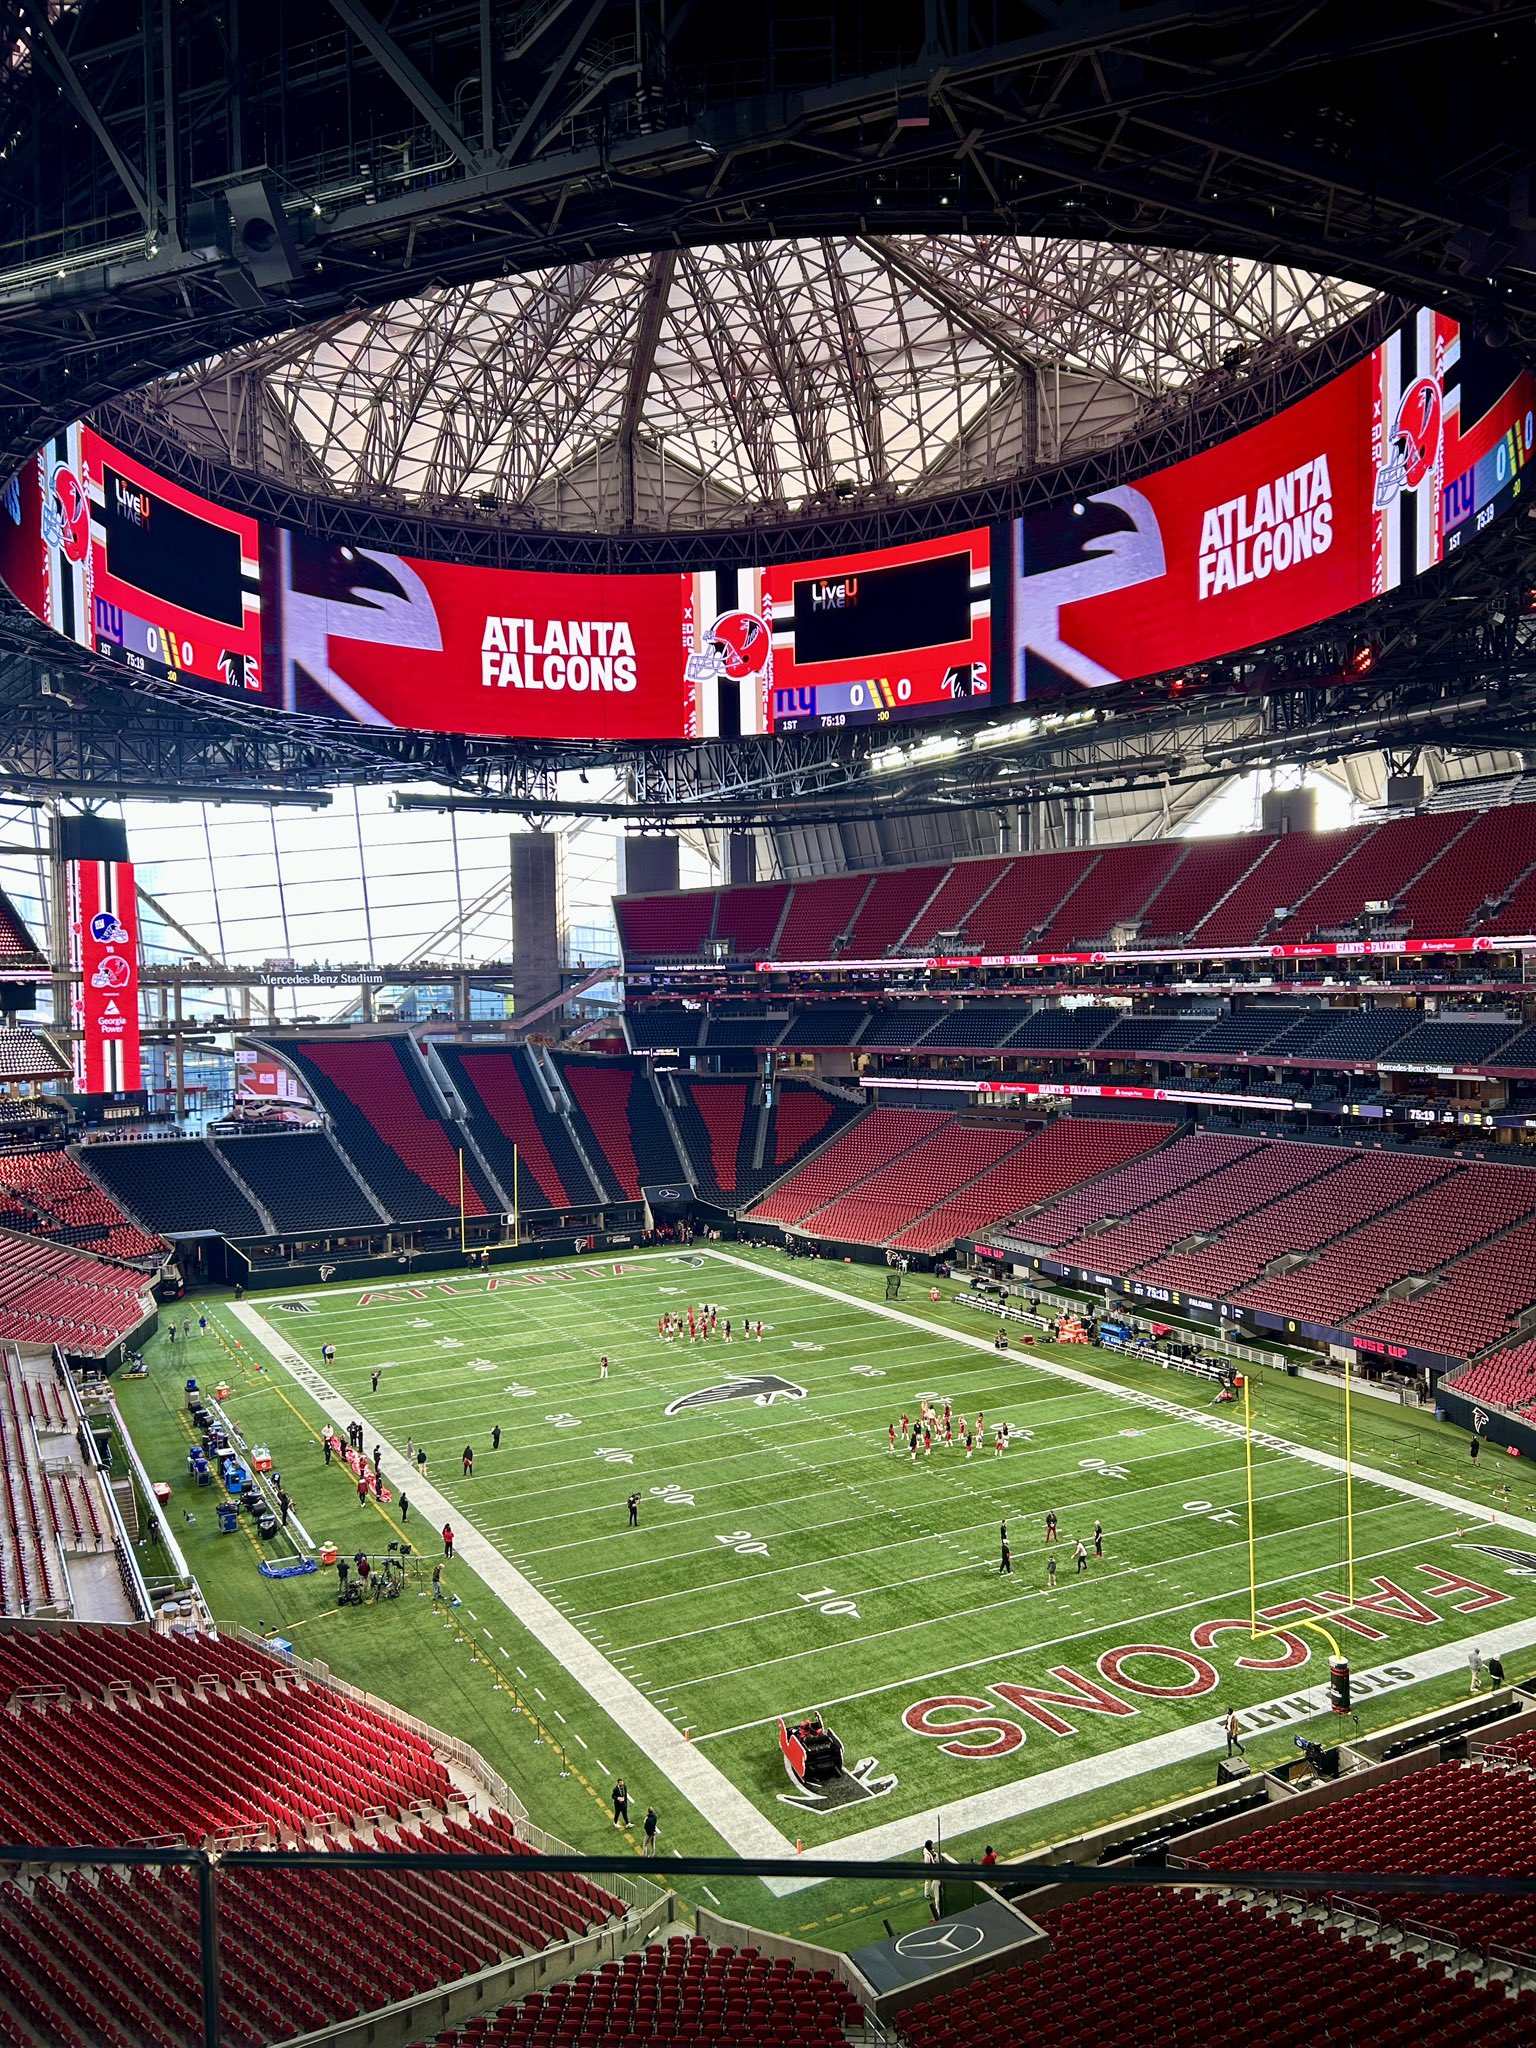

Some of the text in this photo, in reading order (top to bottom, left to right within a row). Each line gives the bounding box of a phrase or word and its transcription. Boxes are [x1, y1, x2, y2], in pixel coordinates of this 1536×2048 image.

[1496, 444, 1506, 481] 0
[115, 478, 150, 517] LiveU
[1199, 453, 1332, 556] ATLANTA
[1448, 531, 1461, 551] 1ST
[1199, 501, 1333, 600] FALCONS
[812, 579, 857, 600] LiveU
[147, 627, 158, 653] 0
[481, 615, 636, 656] ATLANTA
[100, 642, 111, 656] 1ST
[182, 641, 193, 666] 0
[116, 652, 135, 670] 75:19
[481, 651, 637, 692] FALCONS
[850, 685, 864, 706] 0
[897, 678, 911, 700] 0
[782, 720, 797, 731] 1ST
[821, 714, 845, 727] 75:19
[1336, 941, 1406, 954] GIANTS FALCONS
[982, 955, 1038, 966] GIANTS FALCONS
[260, 974, 383, 984] Mercedes-Benz Stadium
[98, 1017, 126, 1027] Georgia
[101, 1025, 124, 1033] Power
[1376, 1062, 1425, 1073] Mercedes-Benz
[1425, 1064, 1454, 1074] Stadium
[1038, 1084, 1102, 1096] GIANTS FALCONS
[1342, 1104, 1349, 1114] 0
[1410, 1110, 1435, 1121] 75:19
[1464, 1114, 1470, 1123] 0
[1486, 1116, 1493, 1126] 0
[974, 1244, 1004, 1258] RISE UP
[357, 1264, 657, 1306] ATLANTA
[1082, 1271, 1088, 1281] 0
[1146, 1286, 1169, 1302] 75:19
[1222, 1305, 1227, 1316] 0
[1288, 1322, 1295, 1332] 0
[1352, 1336, 1408, 1358] RISE UP
[301, 1376, 338, 1400] CHANGE
[545, 1412, 582, 1428] 50
[1118, 1390, 1300, 1452] INSPIRE CHANGE
[593, 1446, 634, 1464] 40
[1078, 1458, 1131, 1476] 20
[650, 1484, 695, 1506] 30
[1182, 1500, 1242, 1523] 10
[714, 1530, 768, 1555] 20
[797, 1586, 857, 1616] 10
[901, 1563, 1515, 1759] FALCONS
[1325, 1666, 1416, 1699] STO
